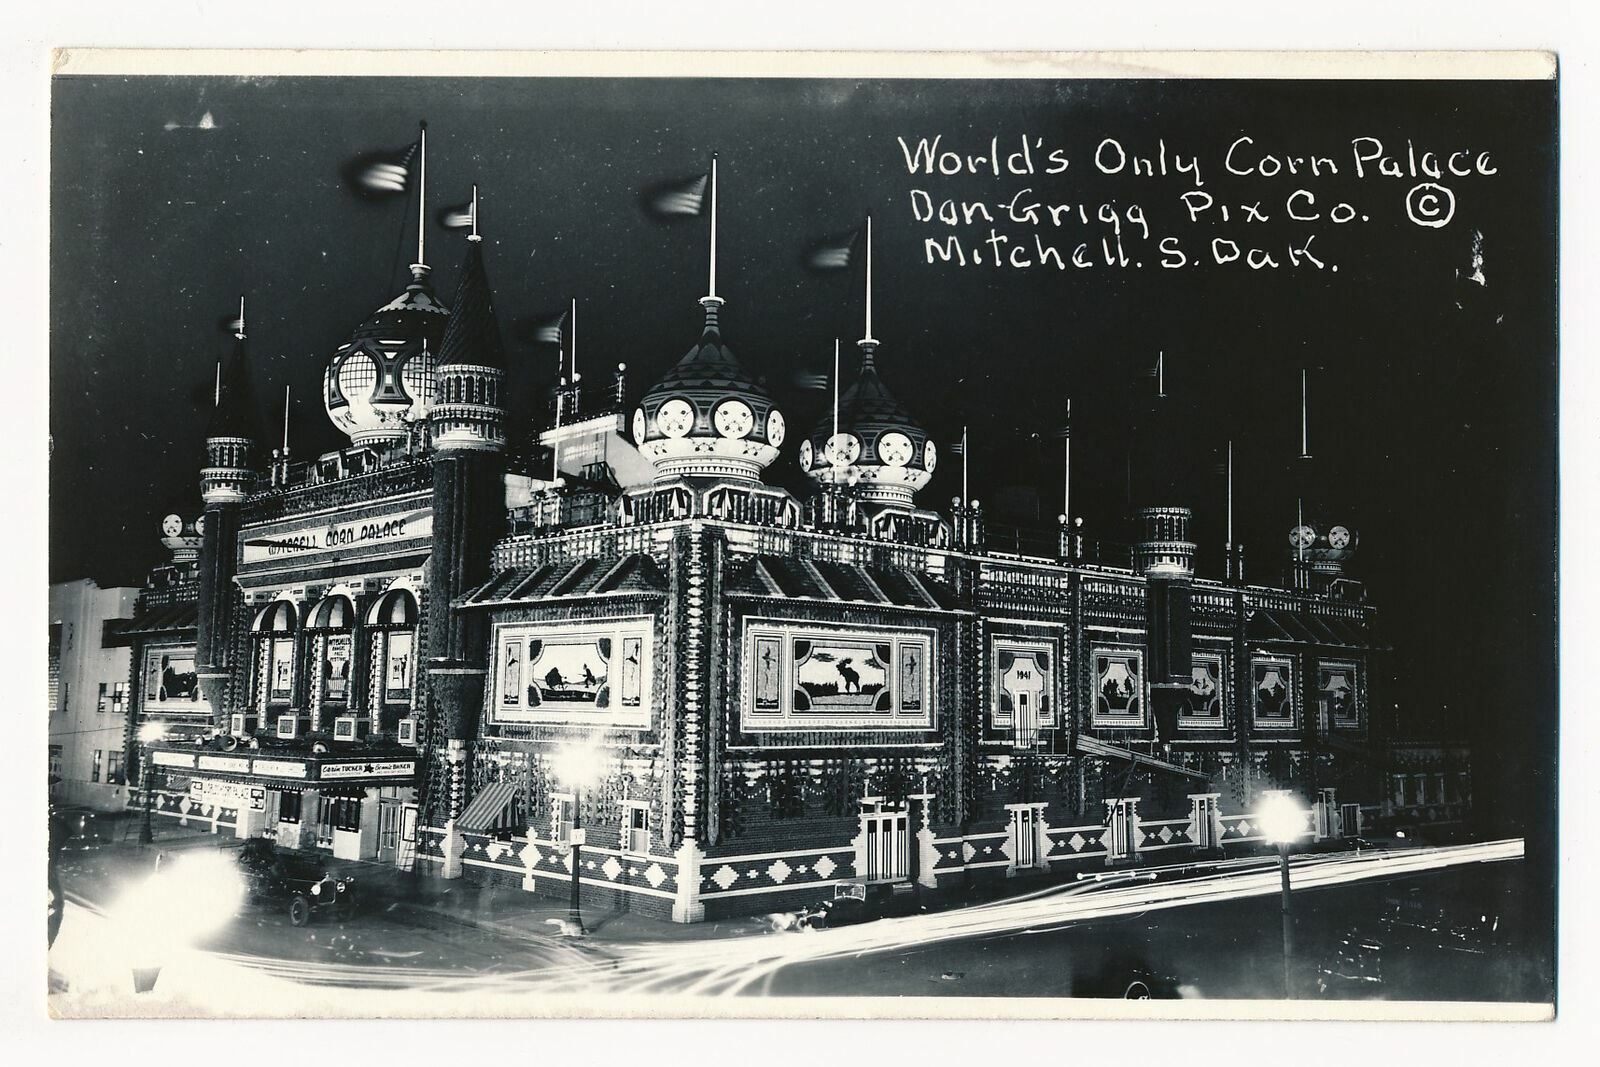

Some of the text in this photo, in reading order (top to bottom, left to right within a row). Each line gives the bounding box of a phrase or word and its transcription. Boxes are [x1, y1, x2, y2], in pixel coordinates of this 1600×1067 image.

[326, 527, 354, 547] CORN
[360, 518, 406, 541] PALACE
[1016, 670, 1031, 680] 1941
